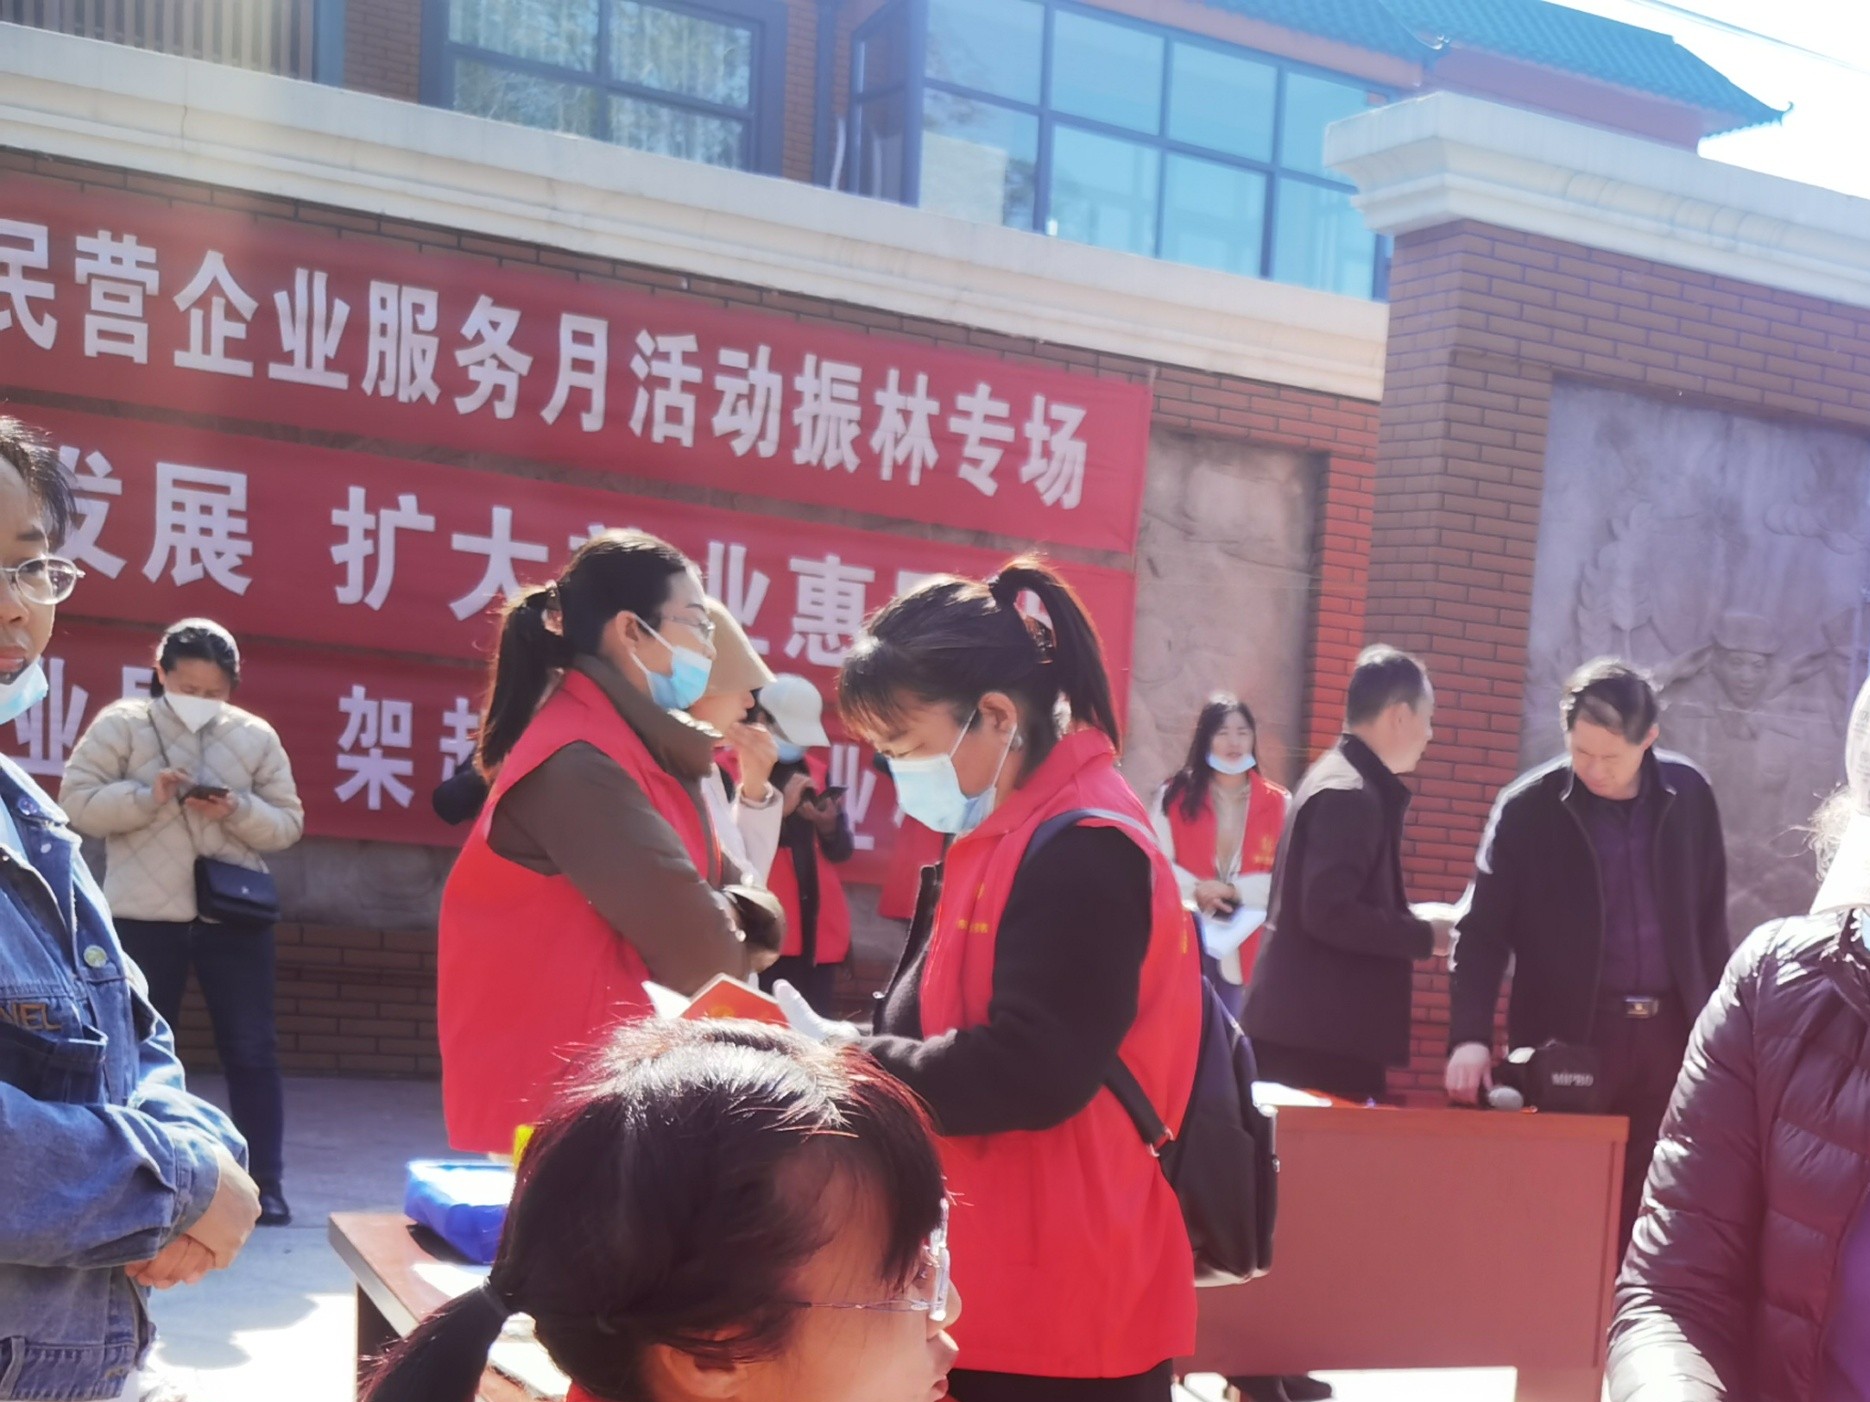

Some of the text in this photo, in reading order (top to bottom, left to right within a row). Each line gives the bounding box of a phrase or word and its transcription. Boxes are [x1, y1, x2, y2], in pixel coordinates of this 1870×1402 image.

[0, 217, 1089, 511] 民营企业服务月活动振林专场
